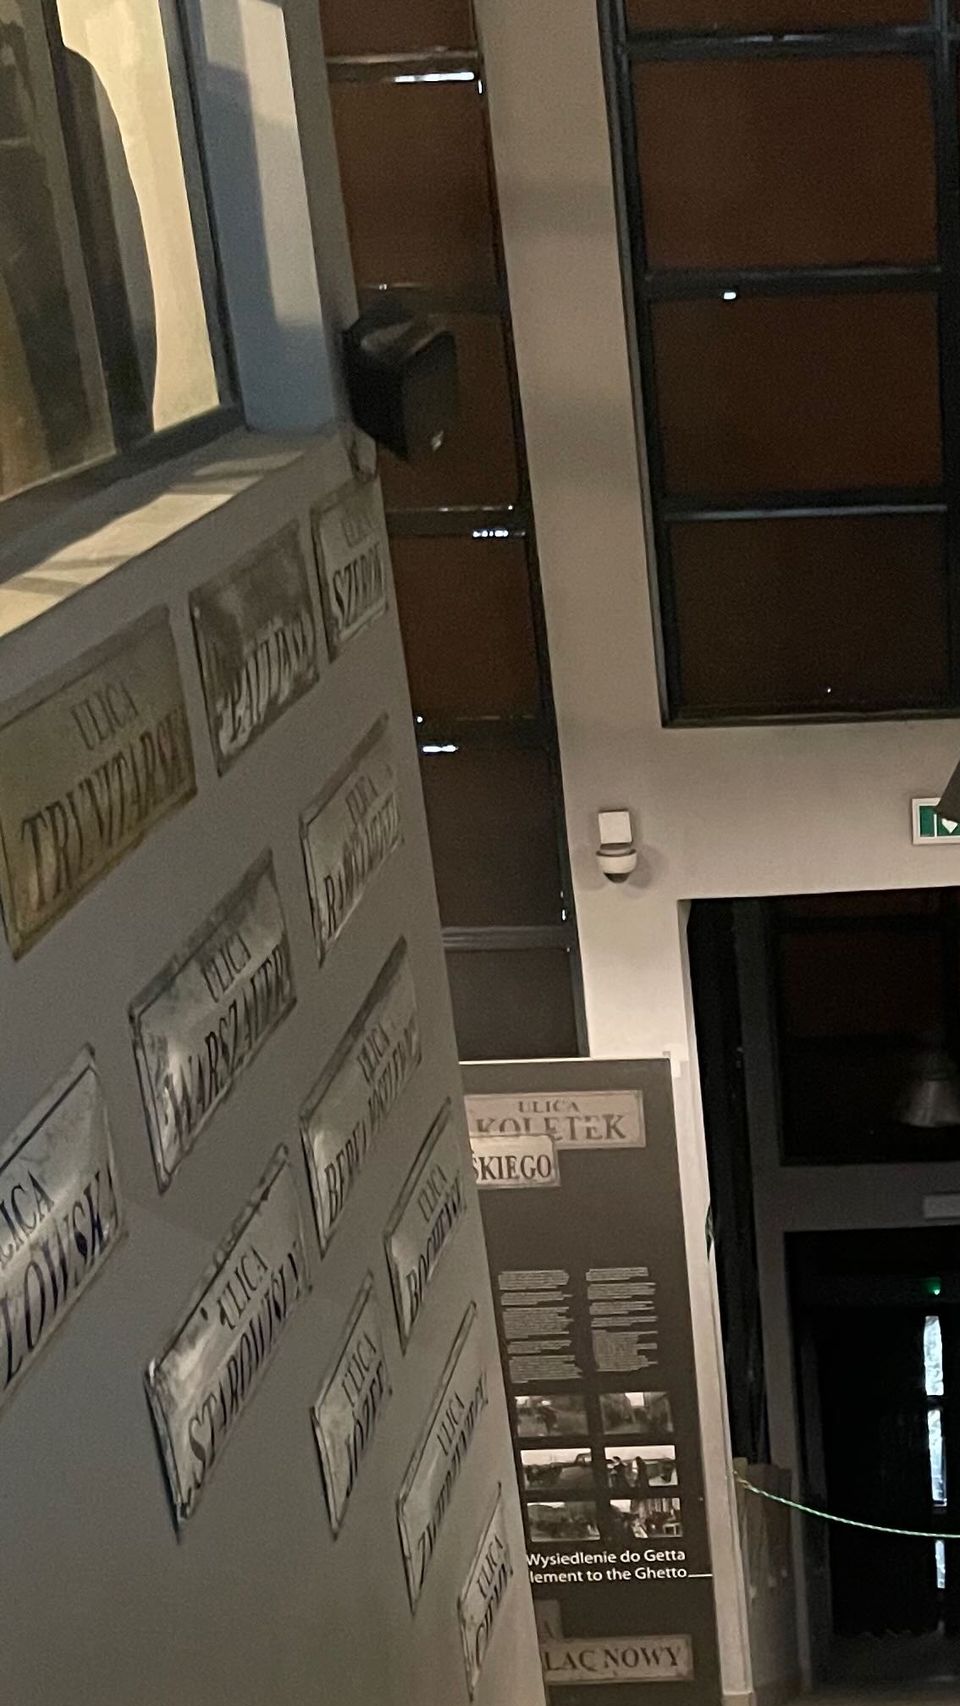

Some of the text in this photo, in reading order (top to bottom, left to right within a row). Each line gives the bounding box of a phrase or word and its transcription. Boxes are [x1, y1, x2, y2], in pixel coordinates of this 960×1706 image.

[518, 1100, 580, 1113] ULICA
[0, 1168, 55, 1264] ICA
[527, 1549, 686, 1569] Wysiedlenie do Getta
[529, 1567, 688, 1584] lement to the Ghetto
[603, 1645, 682, 1669] NOWY
